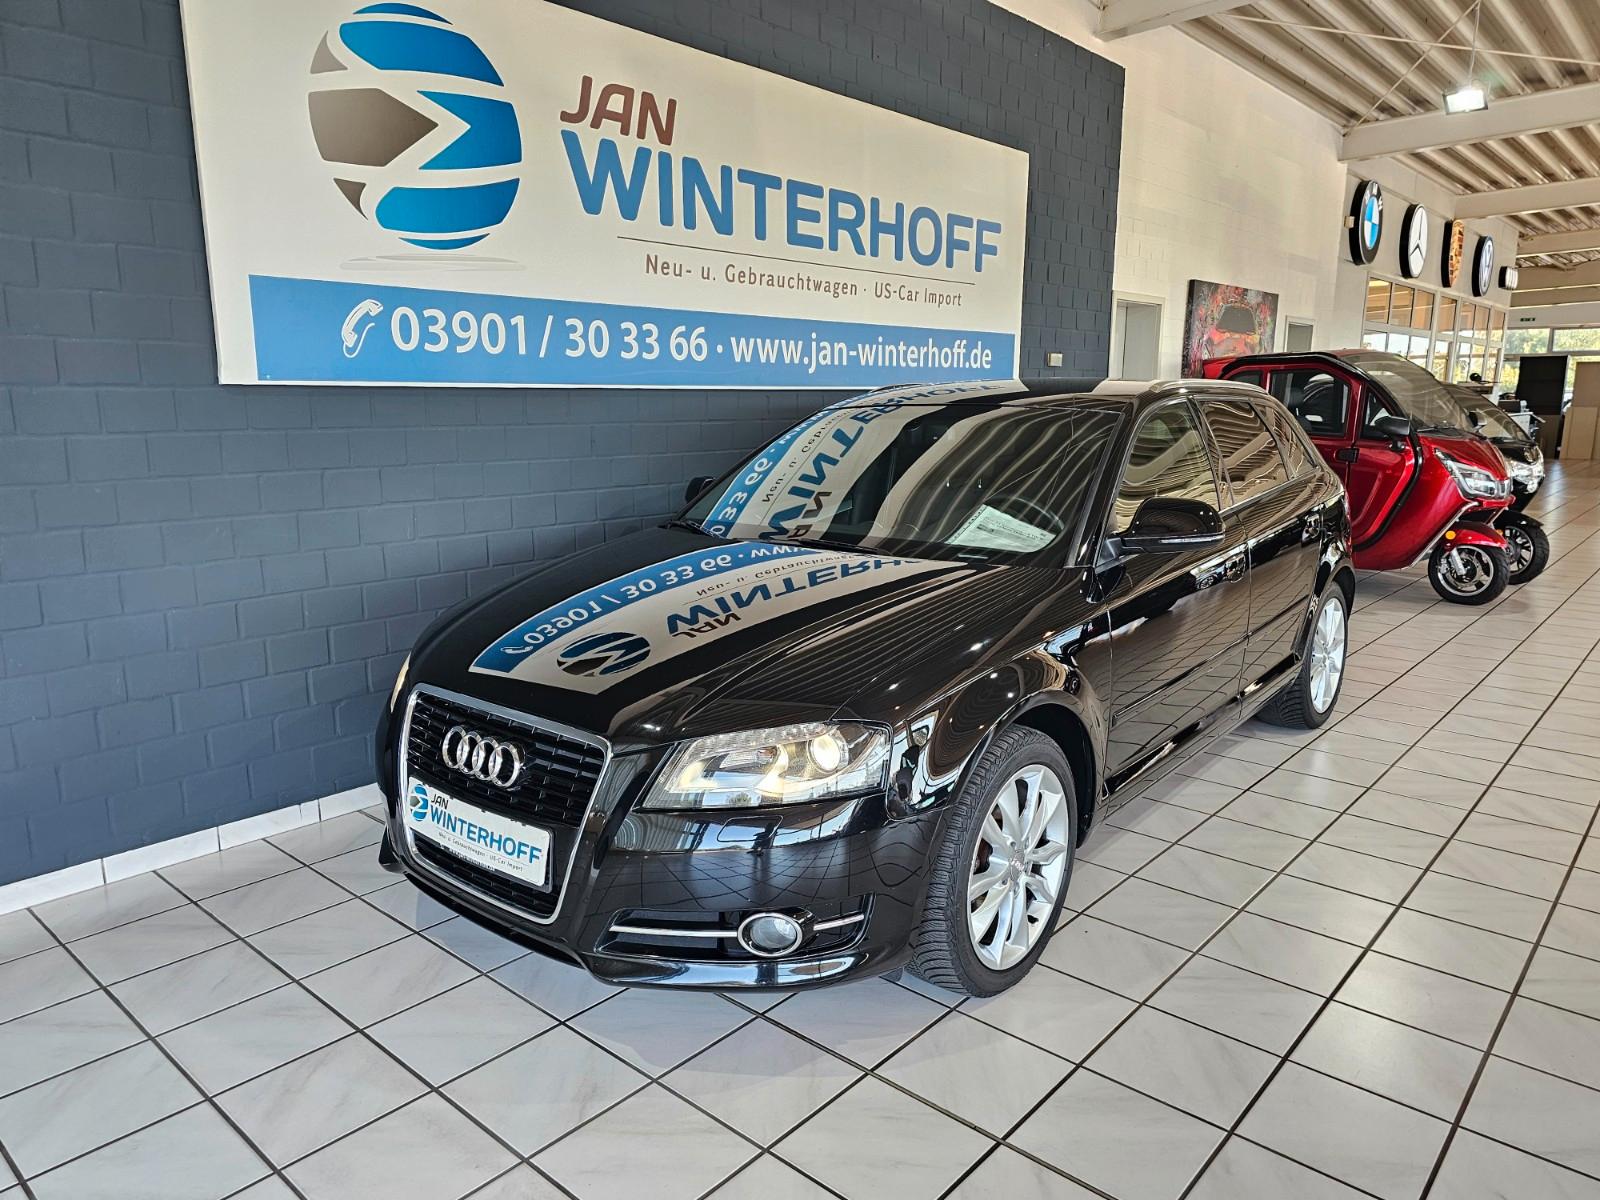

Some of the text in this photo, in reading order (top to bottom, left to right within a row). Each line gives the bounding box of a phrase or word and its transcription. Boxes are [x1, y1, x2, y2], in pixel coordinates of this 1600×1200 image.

[560, 75, 677, 146] JAN
[560, 129, 1002, 273] WINTERHOFF
[645, 253, 692, 277] Neu-
[700, 266, 716, 281] u.
[724, 264, 858, 298] Gebrauchtwagen
[874, 282, 919, 303] US-Car
[923, 288, 962, 308] Import
[390, 306, 527, 355] 03901
[538, 314, 554, 358] /
[564, 317, 610, 358] 30
[620, 320, 661, 360] 33
[669, 325, 708, 362] 66
[730, 331, 992, 374] www.jan-winterhoff.de
[431, 794, 449, 809] JAN
[430, 804, 542, 864] WINTERHOFF
